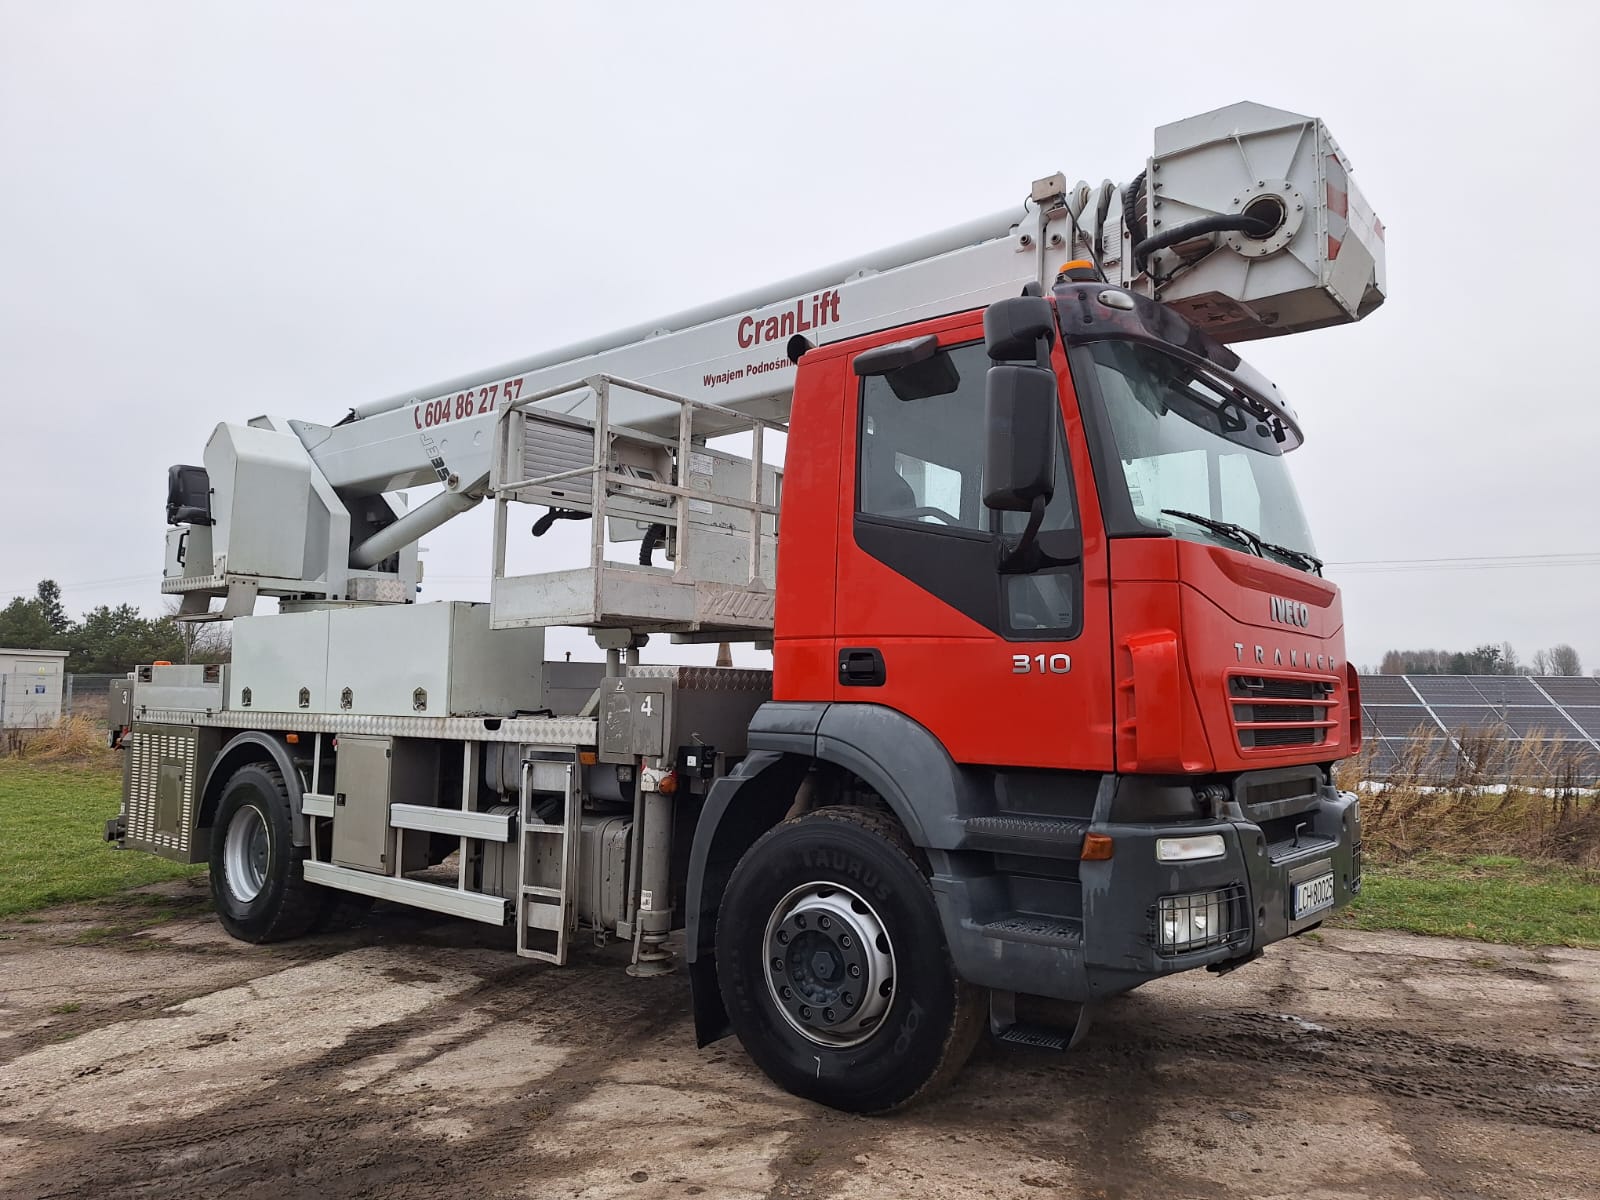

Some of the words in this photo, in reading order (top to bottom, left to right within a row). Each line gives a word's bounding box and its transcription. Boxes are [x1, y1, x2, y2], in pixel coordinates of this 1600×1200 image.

[737, 290, 840, 349] CranLift
[703, 370, 744, 388] Wynajem
[424, 398, 451, 428] 604
[455, 391, 474, 420] 86
[478, 385, 498, 414] 27
[503, 378, 523, 401] 57
[1269, 596, 1309, 628] IVECO
[1012, 653, 1071, 674] 310
[1234, 642, 1335, 672] TRAKKER
[122, 690, 128, 704] 3
[640, 695, 653, 717] 4
